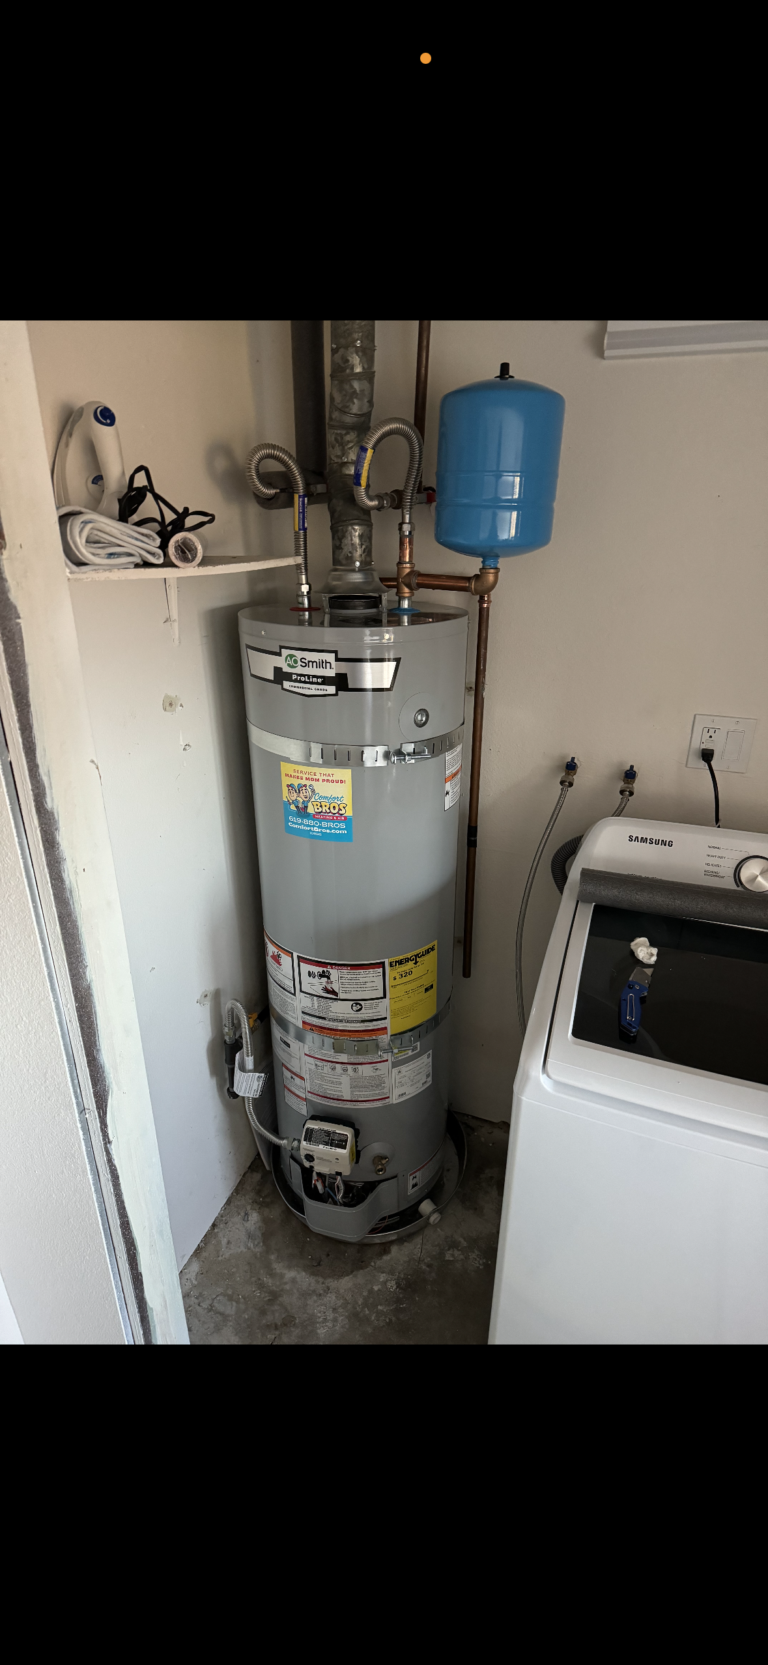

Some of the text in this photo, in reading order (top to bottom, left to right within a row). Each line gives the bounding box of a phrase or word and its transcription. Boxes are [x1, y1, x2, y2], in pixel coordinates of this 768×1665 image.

[314, 793, 344, 803] Comfort
[312, 801, 347, 815] BROS
[288, 822, 347, 833] ComfortBros.com
[628, 834, 674, 848] SAMSUNG
[398, 970, 413, 980] 320
